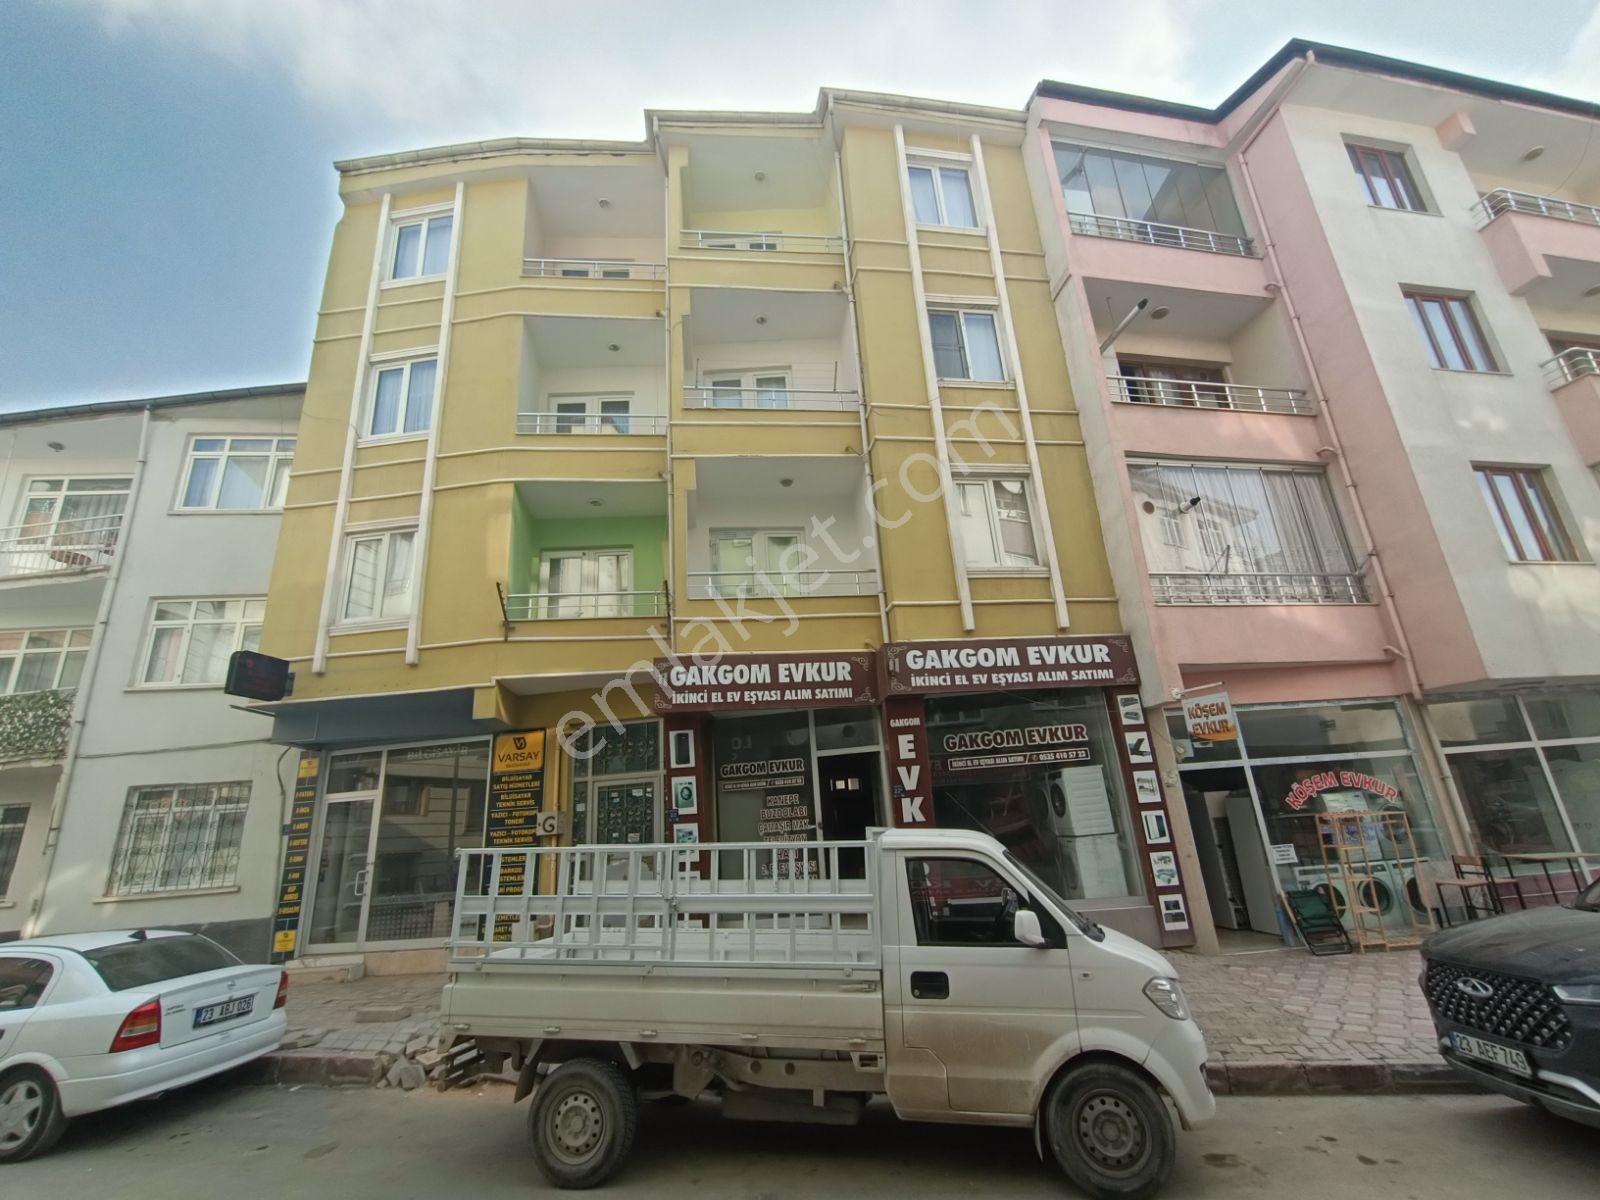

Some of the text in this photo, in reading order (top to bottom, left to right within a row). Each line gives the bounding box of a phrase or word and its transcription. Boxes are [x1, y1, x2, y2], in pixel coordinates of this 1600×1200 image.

[906, 644, 1112, 670] GAKGOM EVKUR
[670, 661, 852, 687] GAKGOM EVKUR
[910, 669, 1114, 687] İKİNCİ EL EV EŞYASI ALIM SATIMI
[672, 688, 853, 705] İKİNCİ EL EV EŞYASI ALIM SATIMI
[889, 717, 921, 728] GAKGOM
[1192, 719, 1231, 736] EVKUR
[944, 723, 1088, 751] GAKGOM EVKUR
[498, 751, 540, 762] VARSAY
[721, 758, 804, 778] GAKGOM EVKUR
[1340, 770, 1398, 804] EVKUR
[766, 794, 800, 807] KANEPE
[760, 806, 808, 821] BUZDOLABI
[202, 1008, 214, 1021] 23
